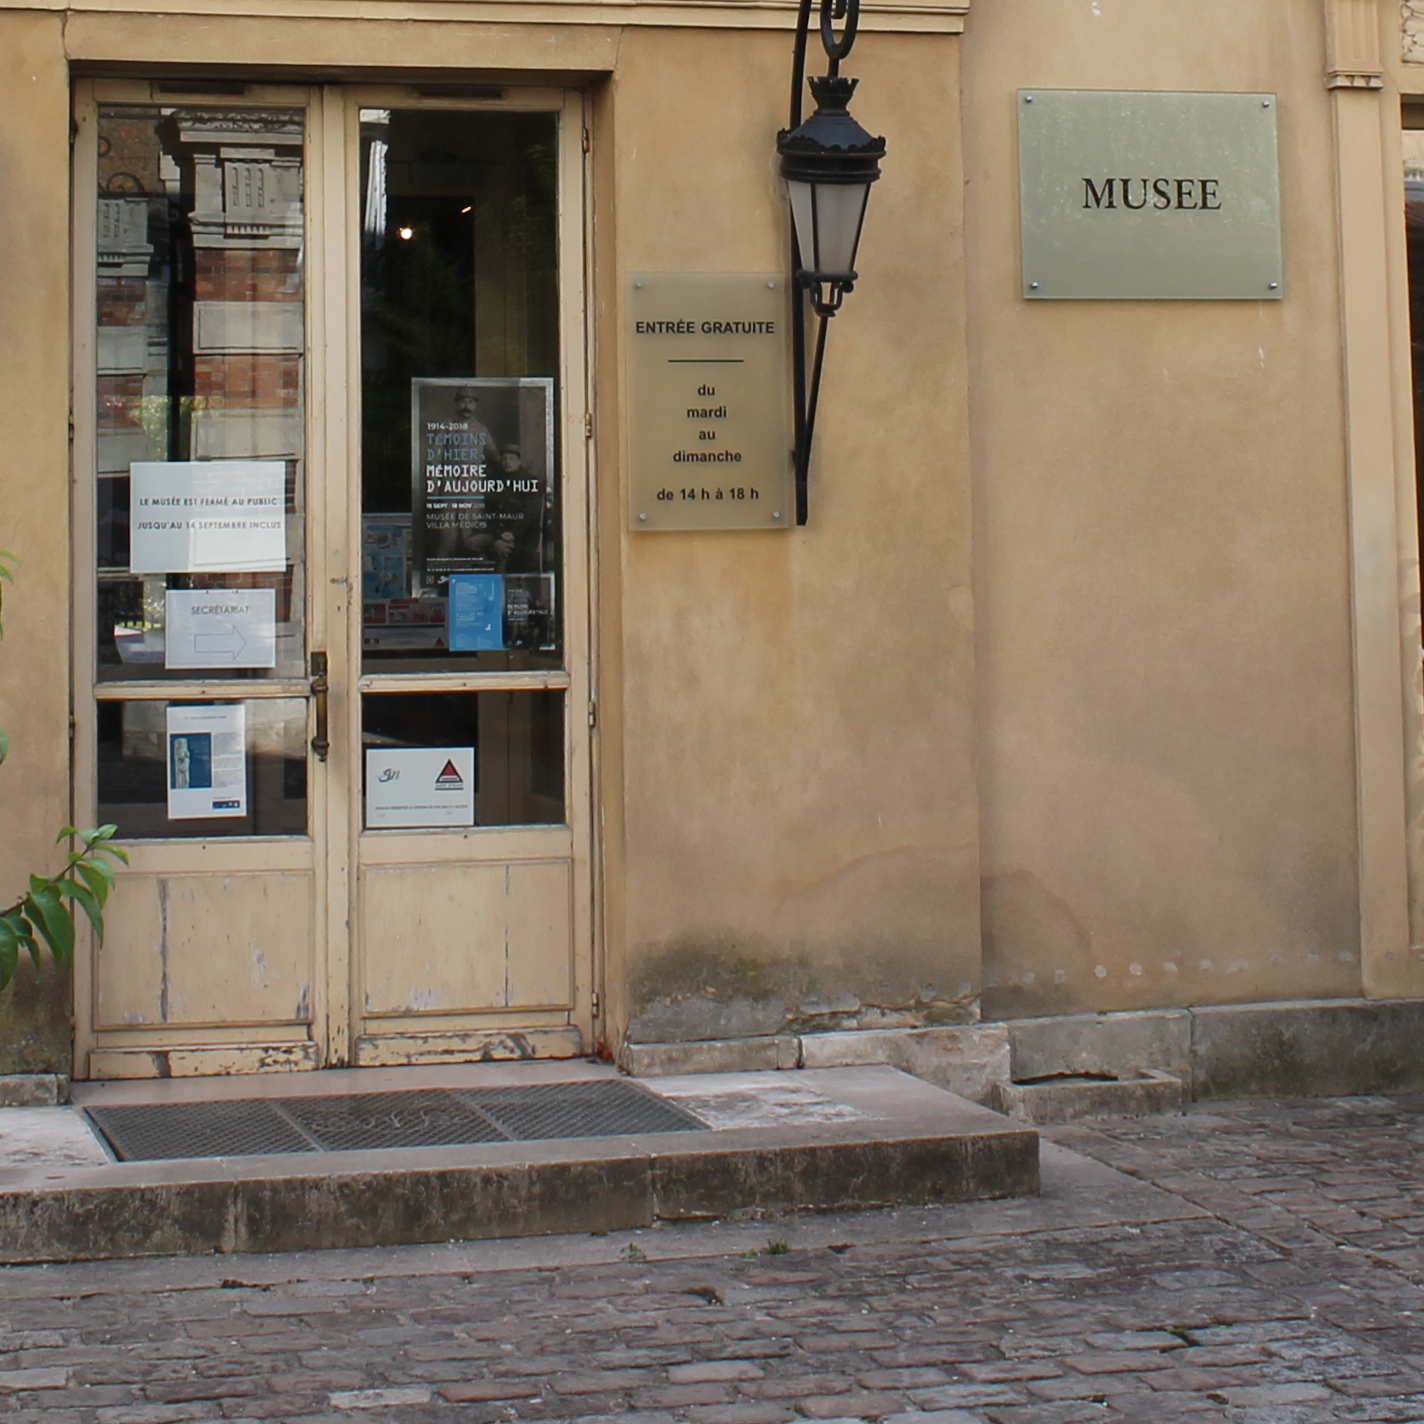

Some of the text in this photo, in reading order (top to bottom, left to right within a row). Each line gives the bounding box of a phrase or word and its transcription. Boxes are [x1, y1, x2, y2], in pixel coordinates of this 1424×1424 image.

[1082, 177, 1222, 210] MUSEE
[636, 319, 775, 334] ENTRÉE GRATUITE
[697, 383, 716, 397] du
[686, 405, 727, 419] mardi
[698, 430, 716, 441] au
[672, 449, 742, 463] dimanche
[426, 464, 487, 478] MÉMOIRE
[426, 479, 539, 493] D'AUJOURD'HUI
[139, 498, 149, 506] LE
[152, 496, 181, 506] MUSÉE
[183, 498, 197, 506] EST
[200, 496, 228, 506] FERMÉ
[656, 487, 759, 501] de 14 h à 18 h
[137, 521, 183, 530] JUSQU'AU
[199, 521, 246, 529] SEPTEMBRE
[249, 521, 281, 529] INCLUS
[191, 604, 249, 615] SECRÉTARIAT
